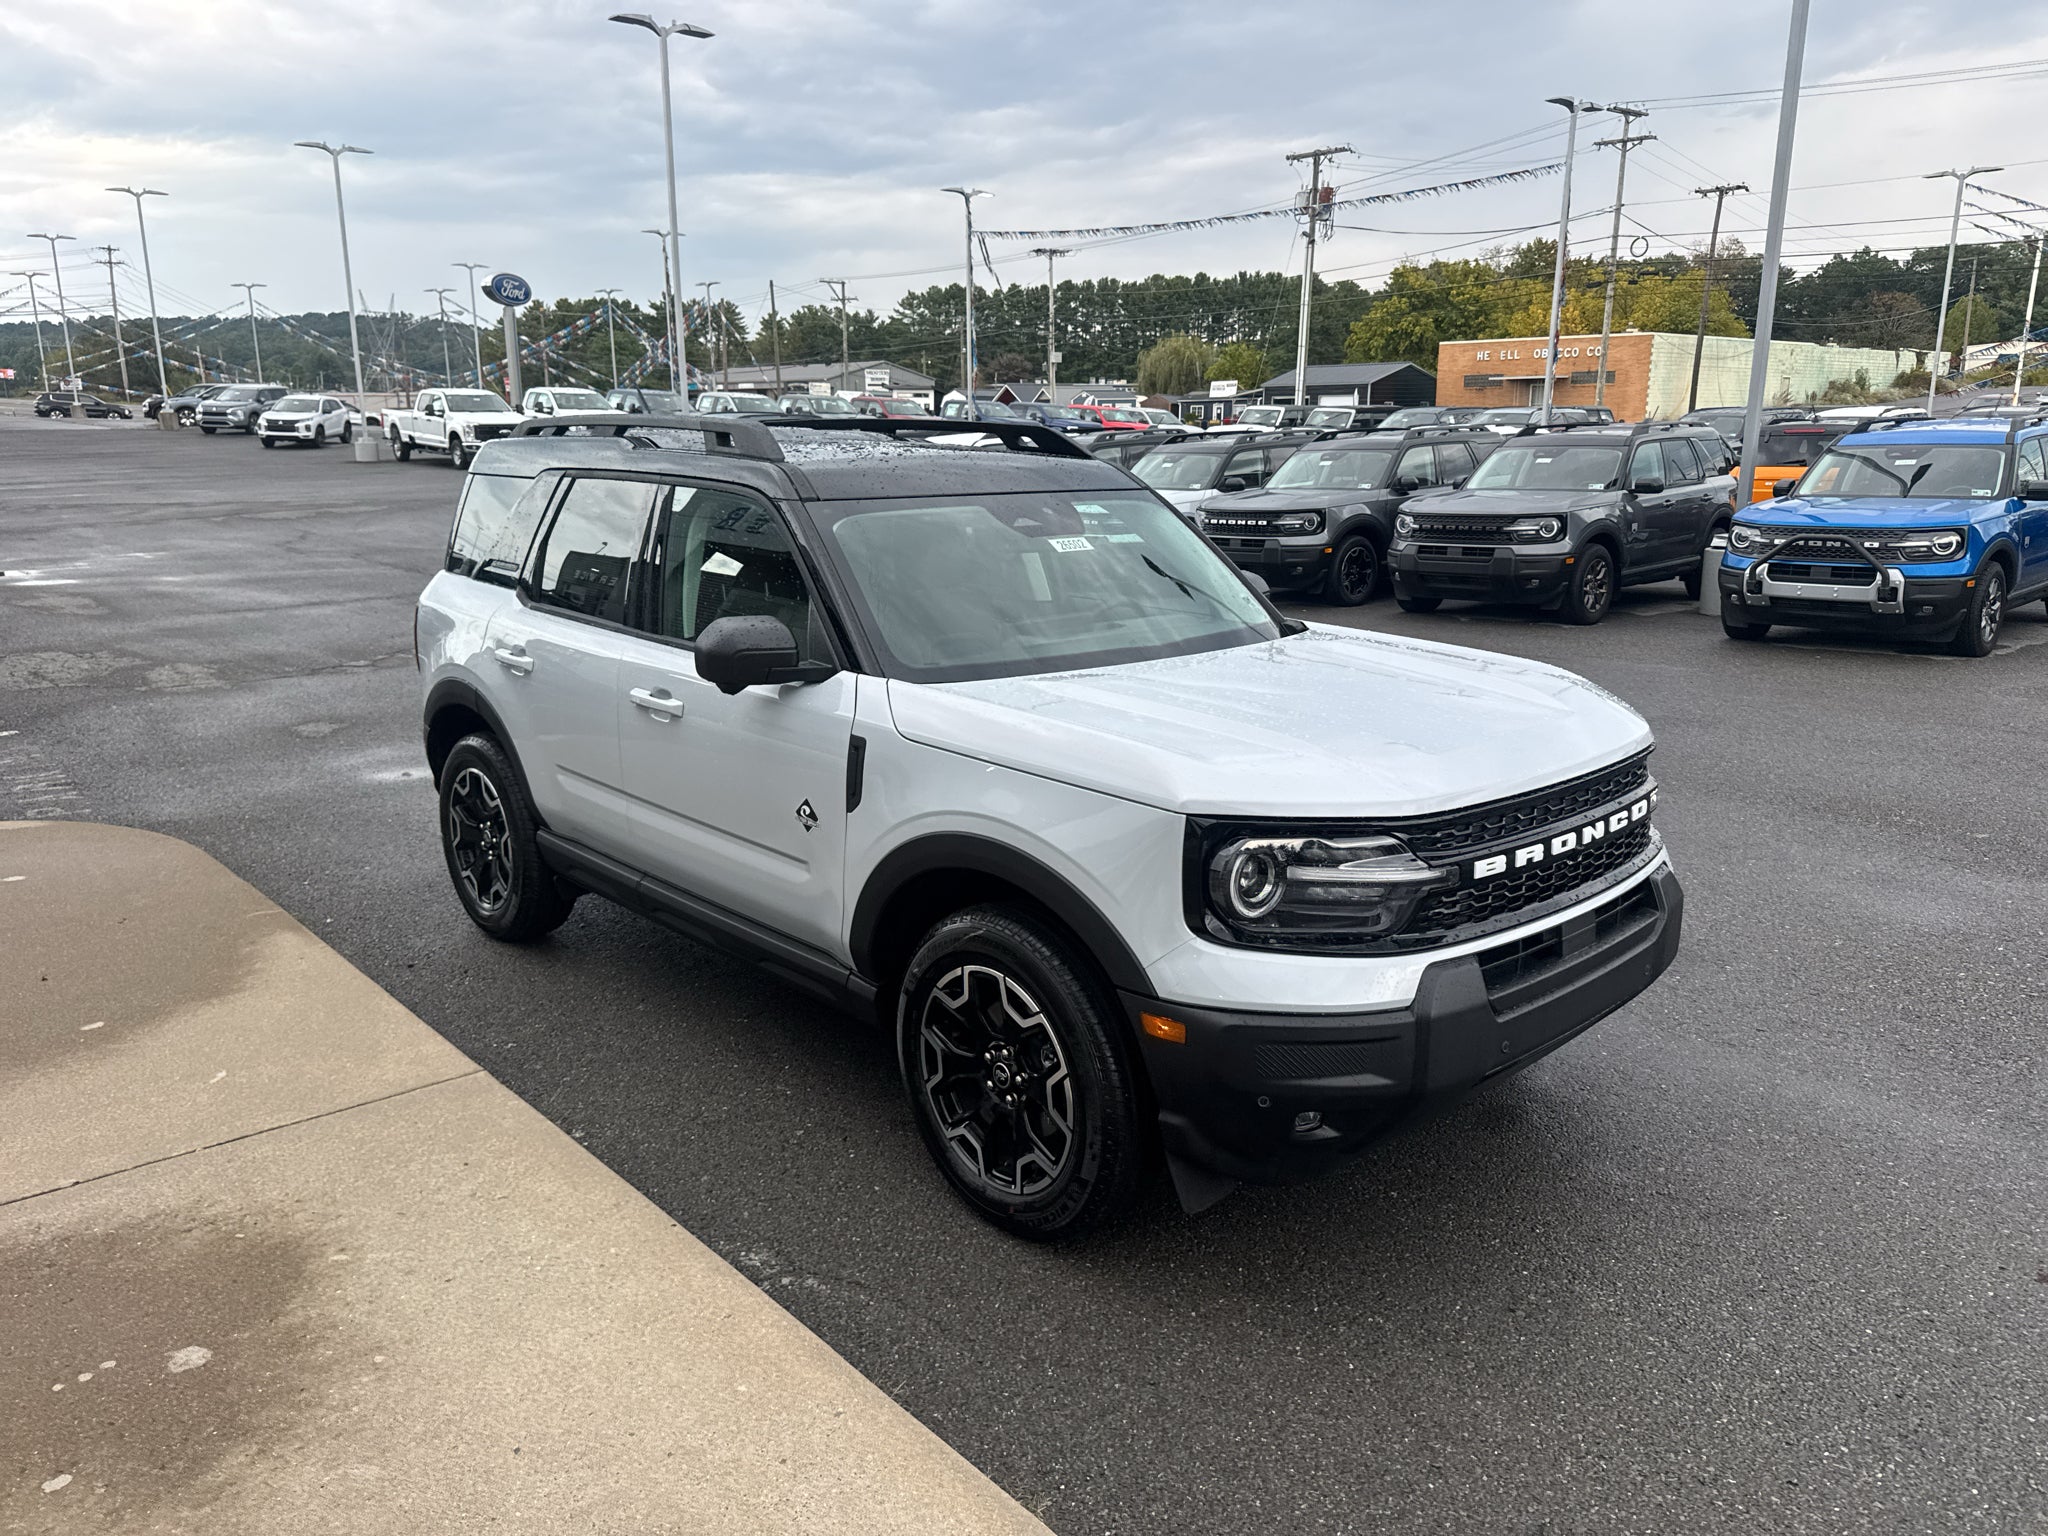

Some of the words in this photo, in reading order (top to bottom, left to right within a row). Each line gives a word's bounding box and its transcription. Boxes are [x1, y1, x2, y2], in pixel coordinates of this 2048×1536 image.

[501, 279, 526, 300] Ford
[1533, 346, 1580, 359] OBCCO
[1421, 524, 1498, 532] BRONCO
[1055, 538, 1089, 551] 26502
[1473, 798, 1648, 880] BRONCO
